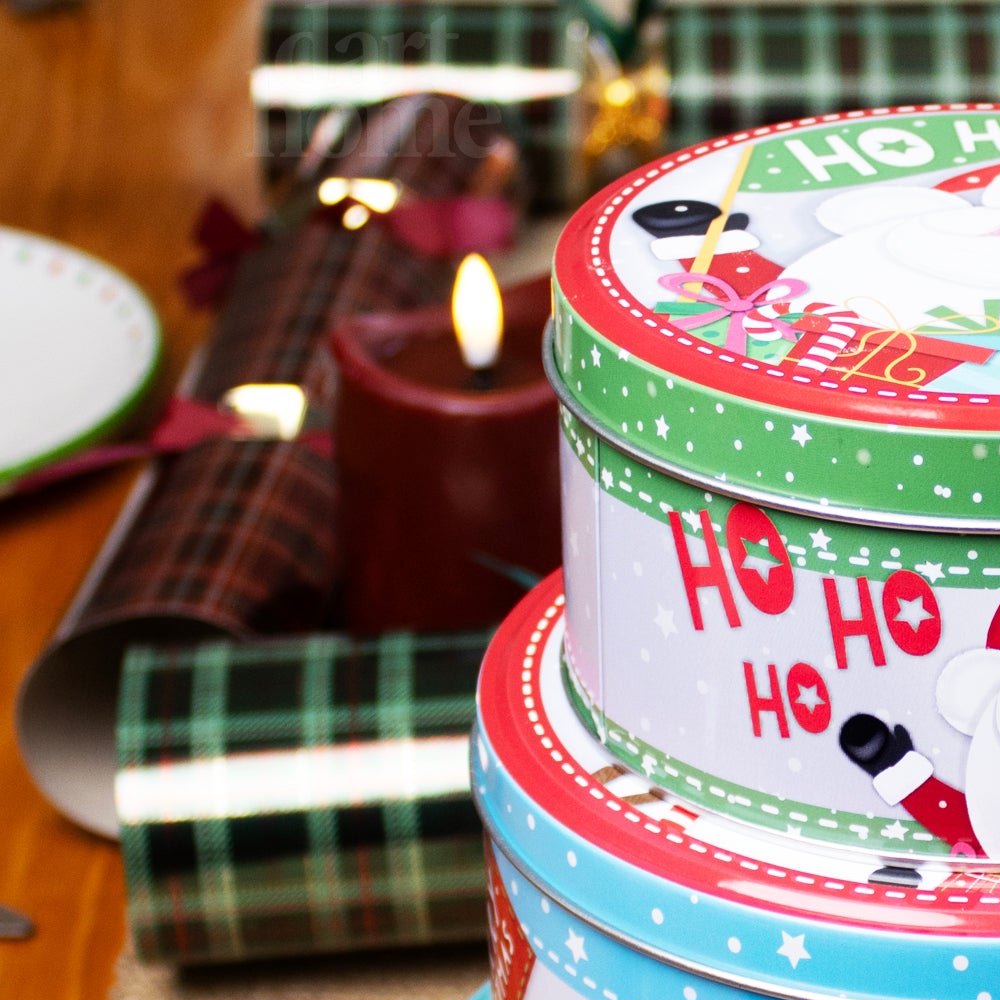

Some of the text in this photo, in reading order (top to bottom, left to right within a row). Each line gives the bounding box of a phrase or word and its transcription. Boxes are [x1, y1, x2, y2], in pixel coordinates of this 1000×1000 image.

[784, 127, 935, 182] HO
[667, 502, 942, 670] HO HO
[743, 661, 832, 739] HO
